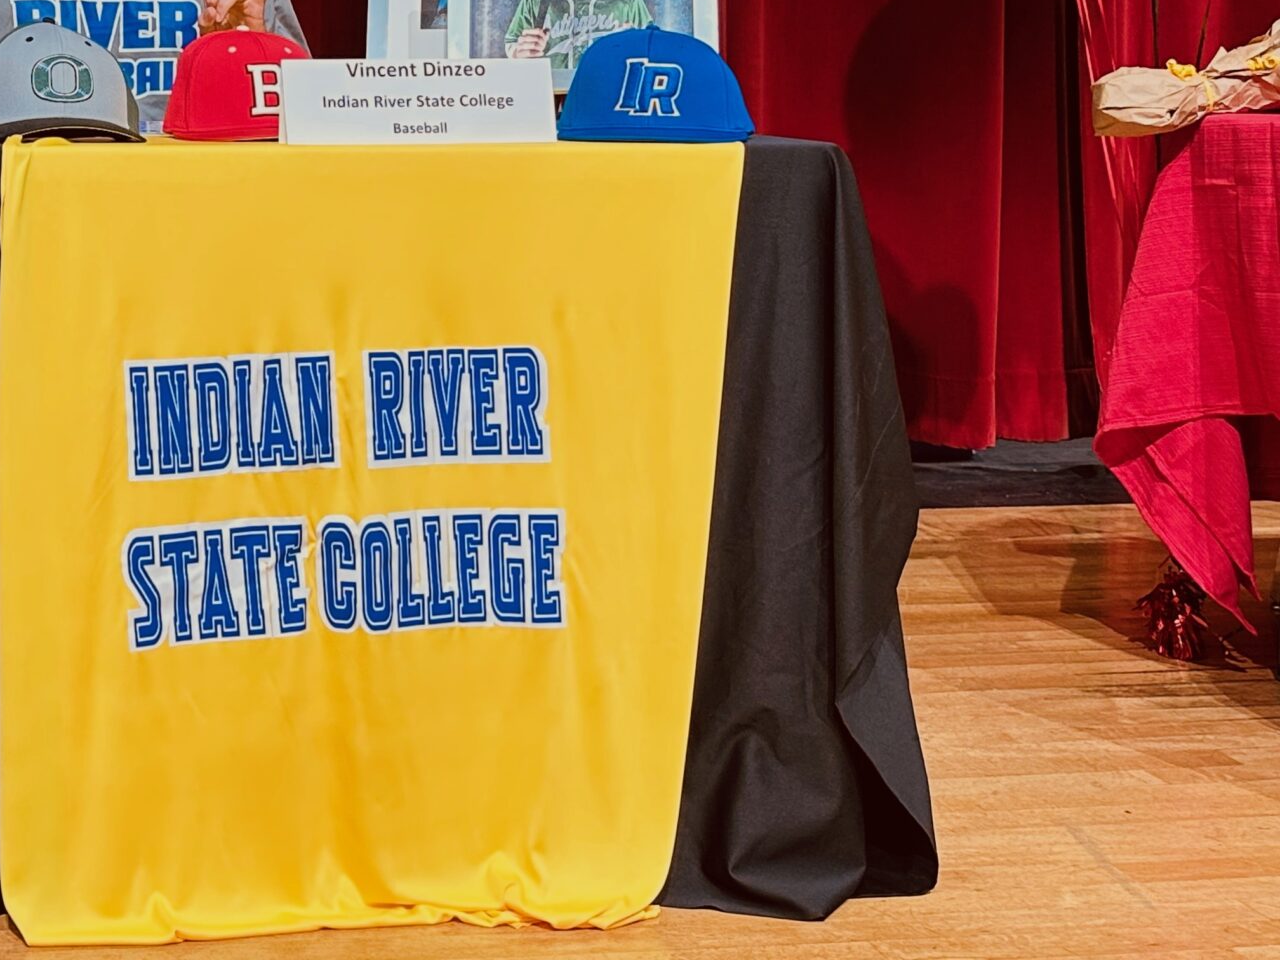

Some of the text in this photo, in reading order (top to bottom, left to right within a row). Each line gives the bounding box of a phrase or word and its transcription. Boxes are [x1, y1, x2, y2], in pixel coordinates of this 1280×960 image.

[246, 63, 280, 117] B
[346, 61, 486, 78] Vincent Dinzeo
[614, 57, 683, 117] IR
[322, 94, 515, 110] Indian River State College
[393, 122, 448, 134] Baseball
[126, 348, 547, 478] INDIAN RIVER
[126, 512, 564, 649] STATE COLLEGE
